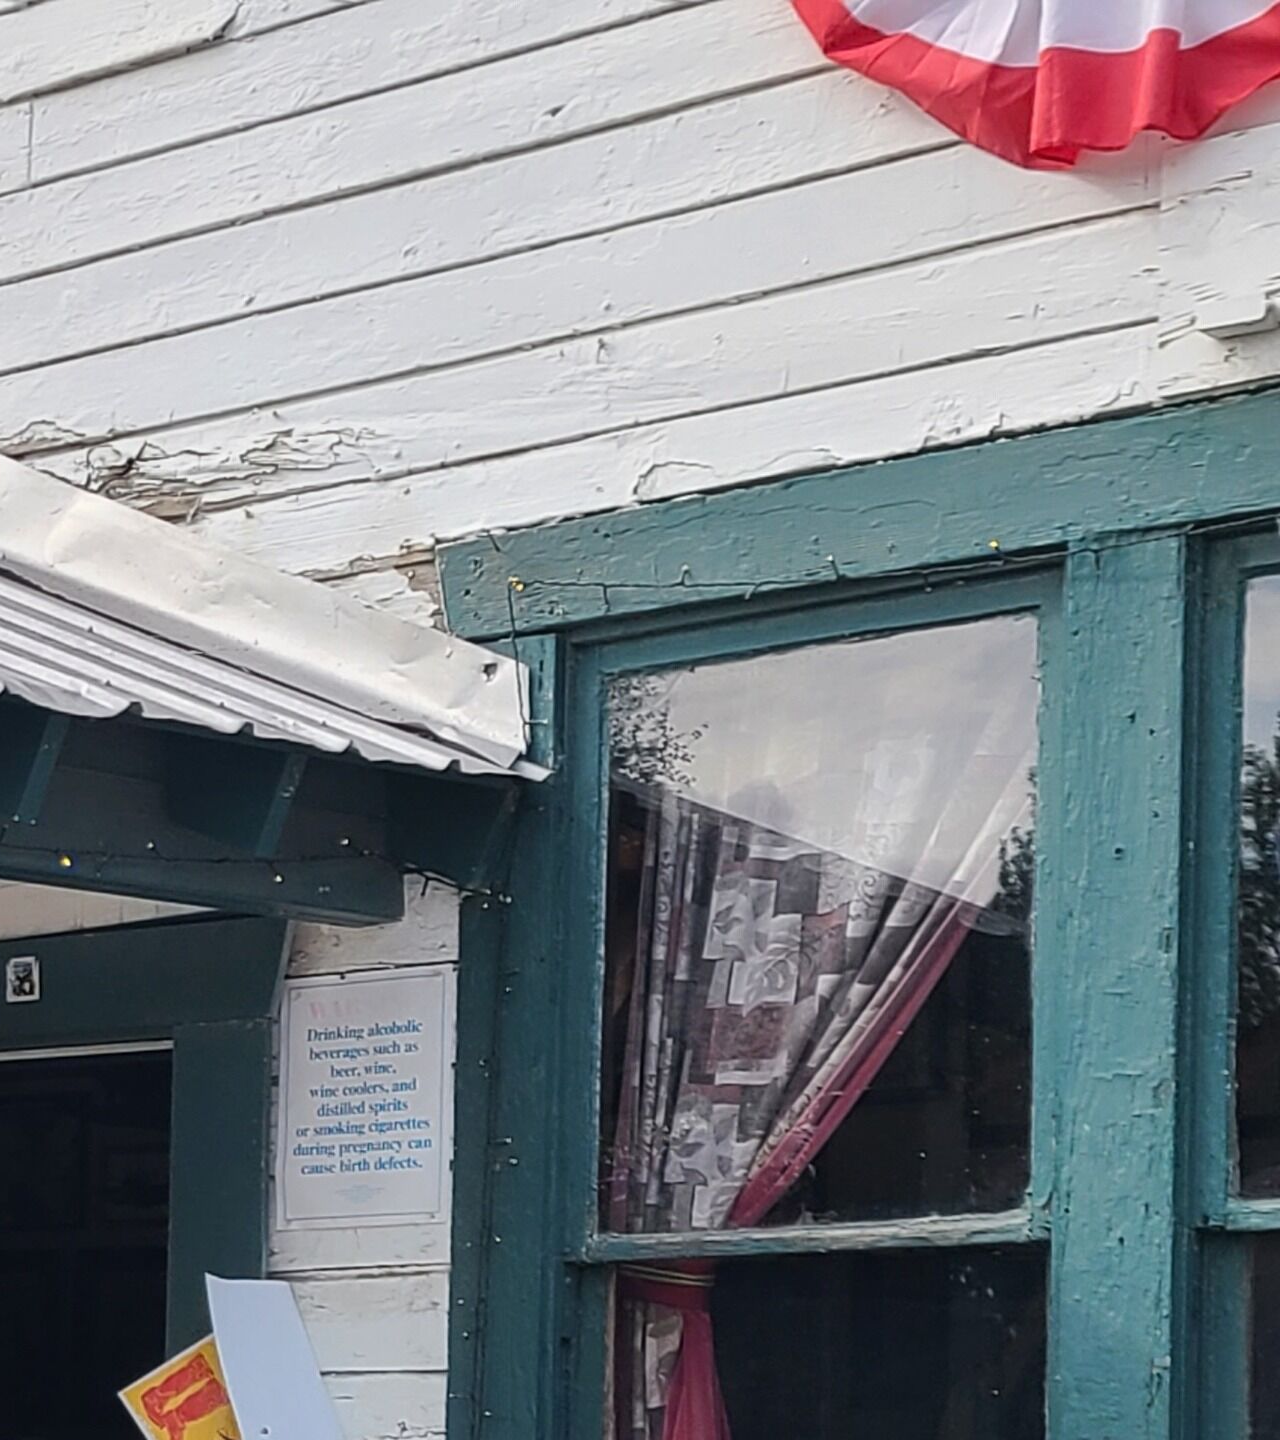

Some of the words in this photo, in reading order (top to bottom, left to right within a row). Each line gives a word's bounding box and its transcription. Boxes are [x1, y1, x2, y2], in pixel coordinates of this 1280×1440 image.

[306, 1026, 364, 1041] Drinking
[367, 1019, 423, 1036] alcoholic
[309, 1047, 370, 1061] beverages
[372, 1040, 401, 1055] such
[404, 1043, 419, 1053] as
[330, 1065, 361, 1078] beer,
[364, 1062, 397, 1076] wine,
[309, 1085, 339, 1098] wine
[342, 1082, 389, 1096] coolers,
[392, 1078, 417, 1092] and
[317, 1100, 365, 1117] distilled
[368, 1099, 408, 1117] spirits
[296, 1126, 310, 1137] or
[313, 1122, 365, 1136] smoking
[368, 1118, 430, 1133] cigarettes
[293, 1143, 335, 1157] during
[339, 1140, 402, 1157] pregnancy
[408, 1138, 432, 1149] can
[301, 1164, 336, 1175] cause
[340, 1158, 370, 1173] birth
[374, 1156, 422, 1171] defects.
